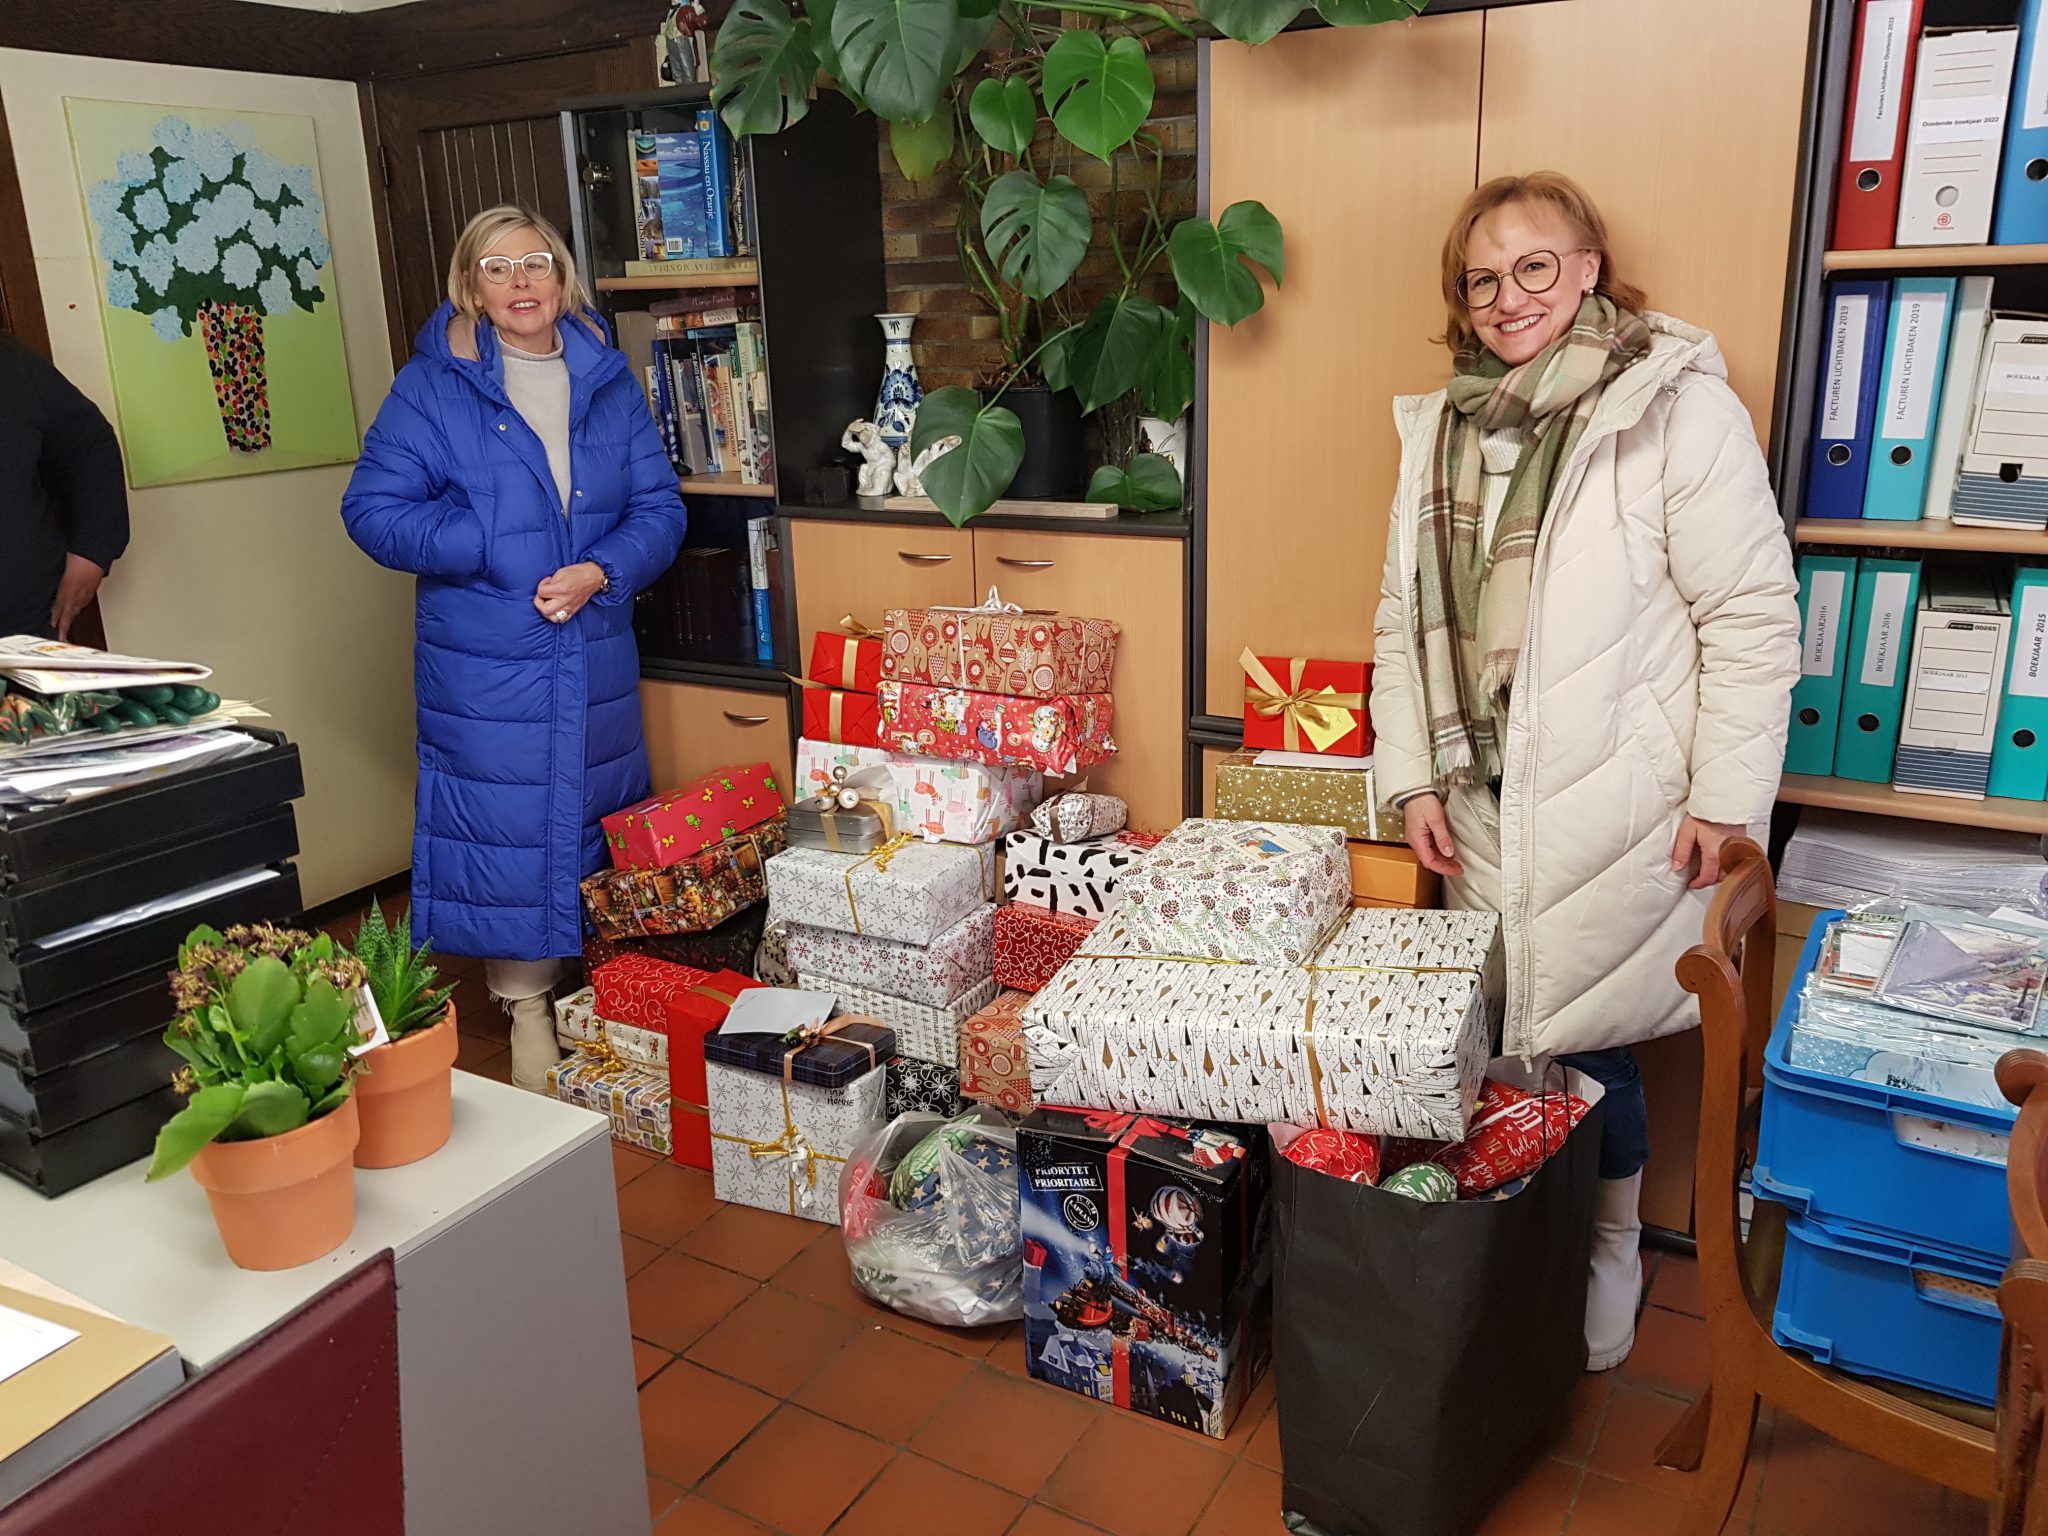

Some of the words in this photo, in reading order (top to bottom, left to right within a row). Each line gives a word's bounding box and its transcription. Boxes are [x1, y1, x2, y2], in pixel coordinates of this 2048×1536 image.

[1921, 119, 1953, 127] Oostende
[702, 141, 711, 174] Nassau
[704, 175, 711, 187] en
[706, 187, 716, 220] Oranje
[1839, 305, 1849, 326] 2019
[1910, 303, 1921, 323] 2019
[1834, 327, 1847, 378] LICHTBAKEN
[1903, 325, 1918, 376] LICHTBAKEN
[1829, 379, 1841, 421] FACTUREN
[1896, 377, 1909, 420] FACTUREN
[1815, 605, 1828, 663] BOEKJAAR2016
[1875, 633, 1889, 673] BOEKJAAR
[1884, 612, 1892, 632] 2016
[2028, 635, 2042, 678] BOEKJAAR
[2037, 613, 2047, 634] 2015
[896, 1028, 905, 1056] merr
[1507, 1134, 1541, 1157] holly
[1034, 1178, 1098, 1187] PRIORITAIRE
[1068, 1200, 1095, 1226] LAPLAND
